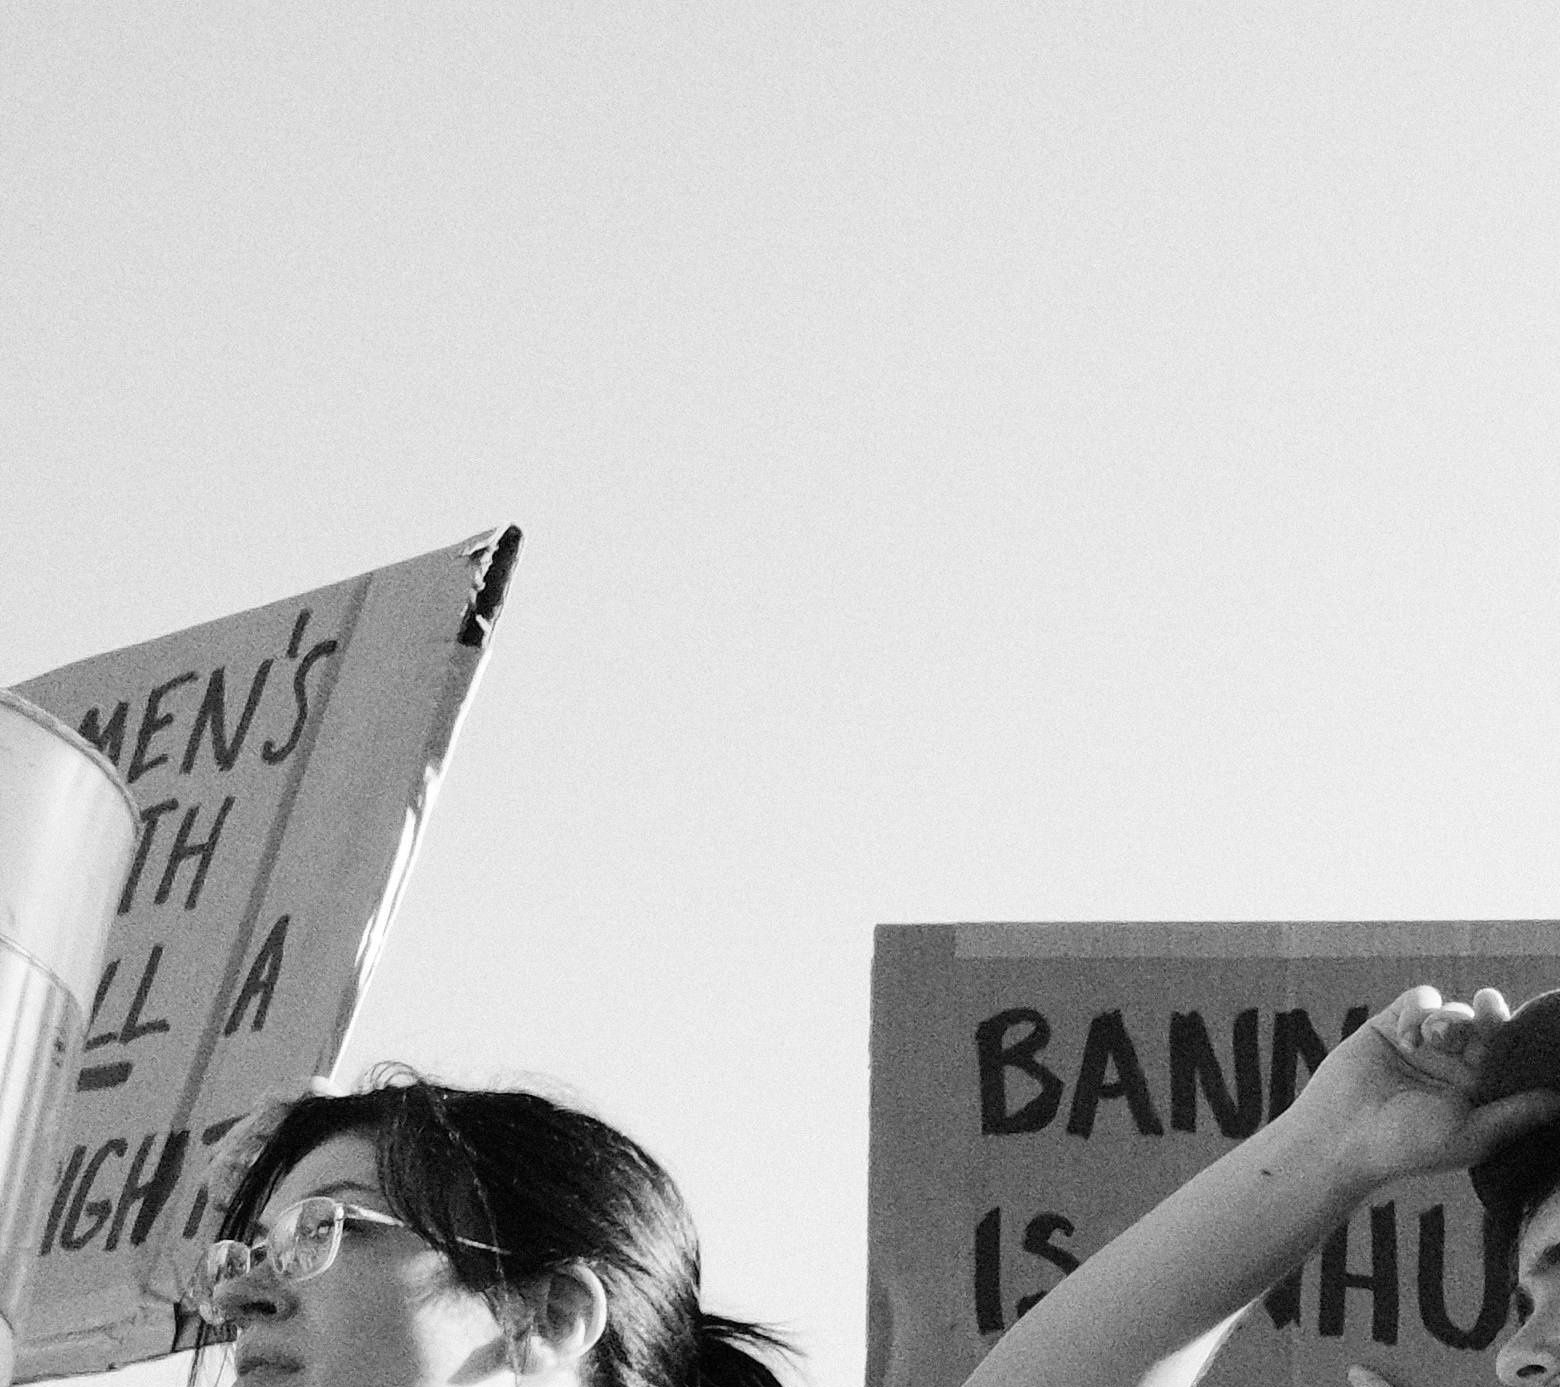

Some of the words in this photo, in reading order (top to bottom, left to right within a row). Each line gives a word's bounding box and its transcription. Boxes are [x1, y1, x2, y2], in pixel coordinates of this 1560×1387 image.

[77, 607, 338, 784] MEN'S
[223, 914, 291, 1039] A
[974, 1006, 1370, 1142] BANN
